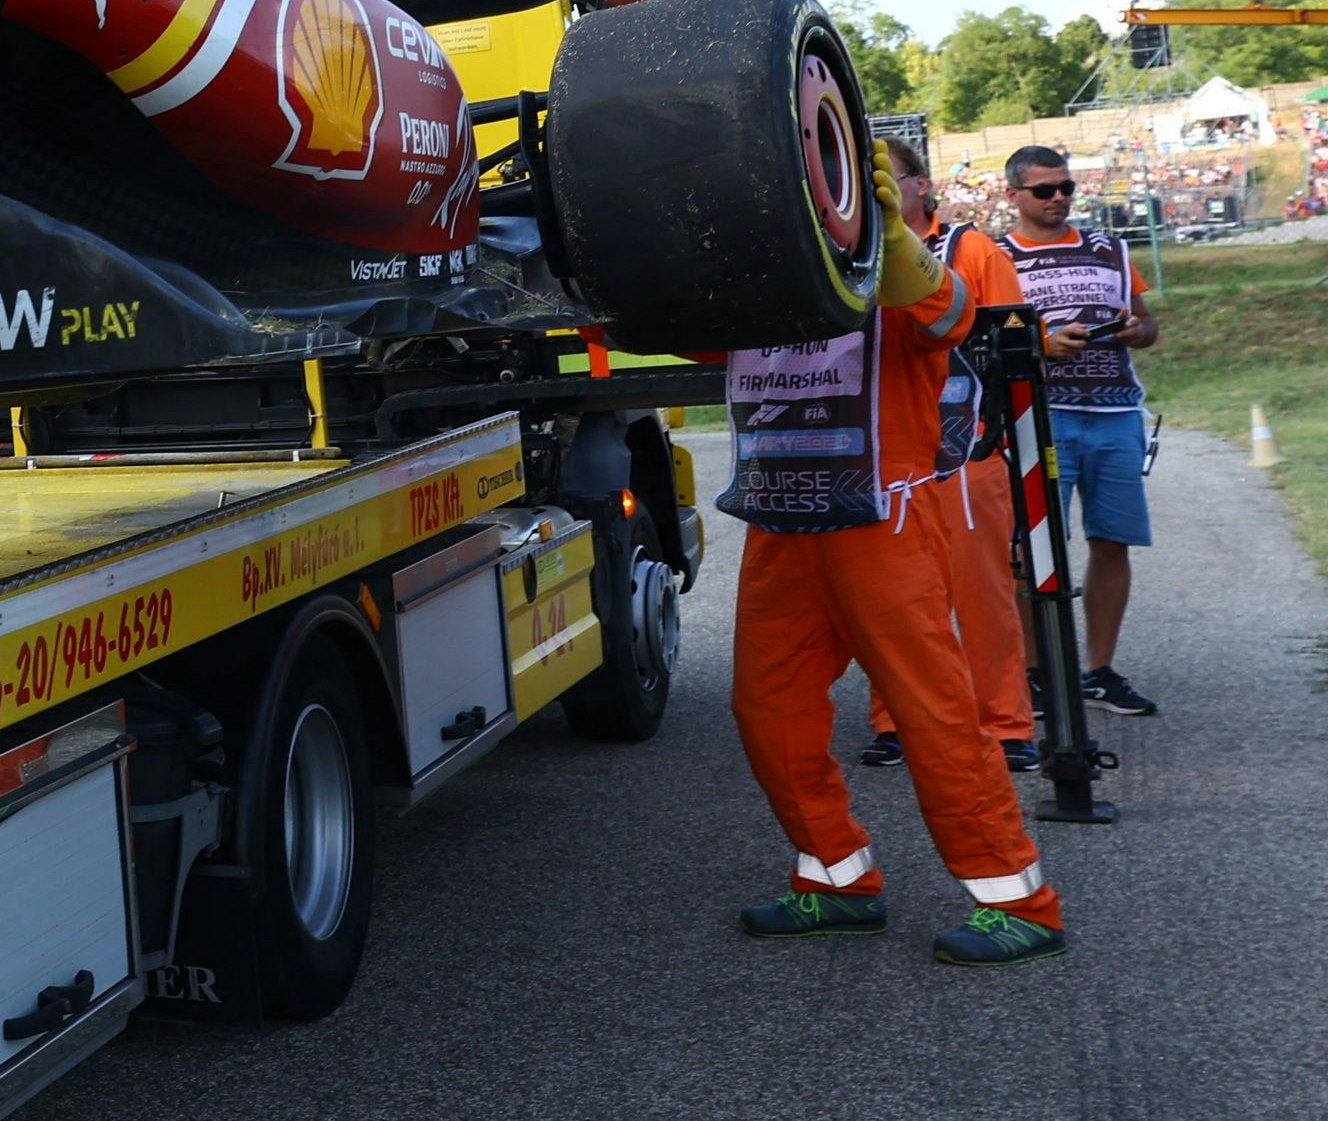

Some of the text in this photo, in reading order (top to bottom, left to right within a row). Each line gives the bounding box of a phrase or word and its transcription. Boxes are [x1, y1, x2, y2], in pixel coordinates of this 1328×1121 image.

[399, 111, 450, 159] PERONI
[419, 254, 442, 277] SKF
[61, 301, 141, 346] PLAY
[1050, 364, 1120, 378] ACCESS
[739, 470, 832, 491] COURSE
[409, 481, 440, 538] TPZS
[744, 492, 831, 513] ACCESS
